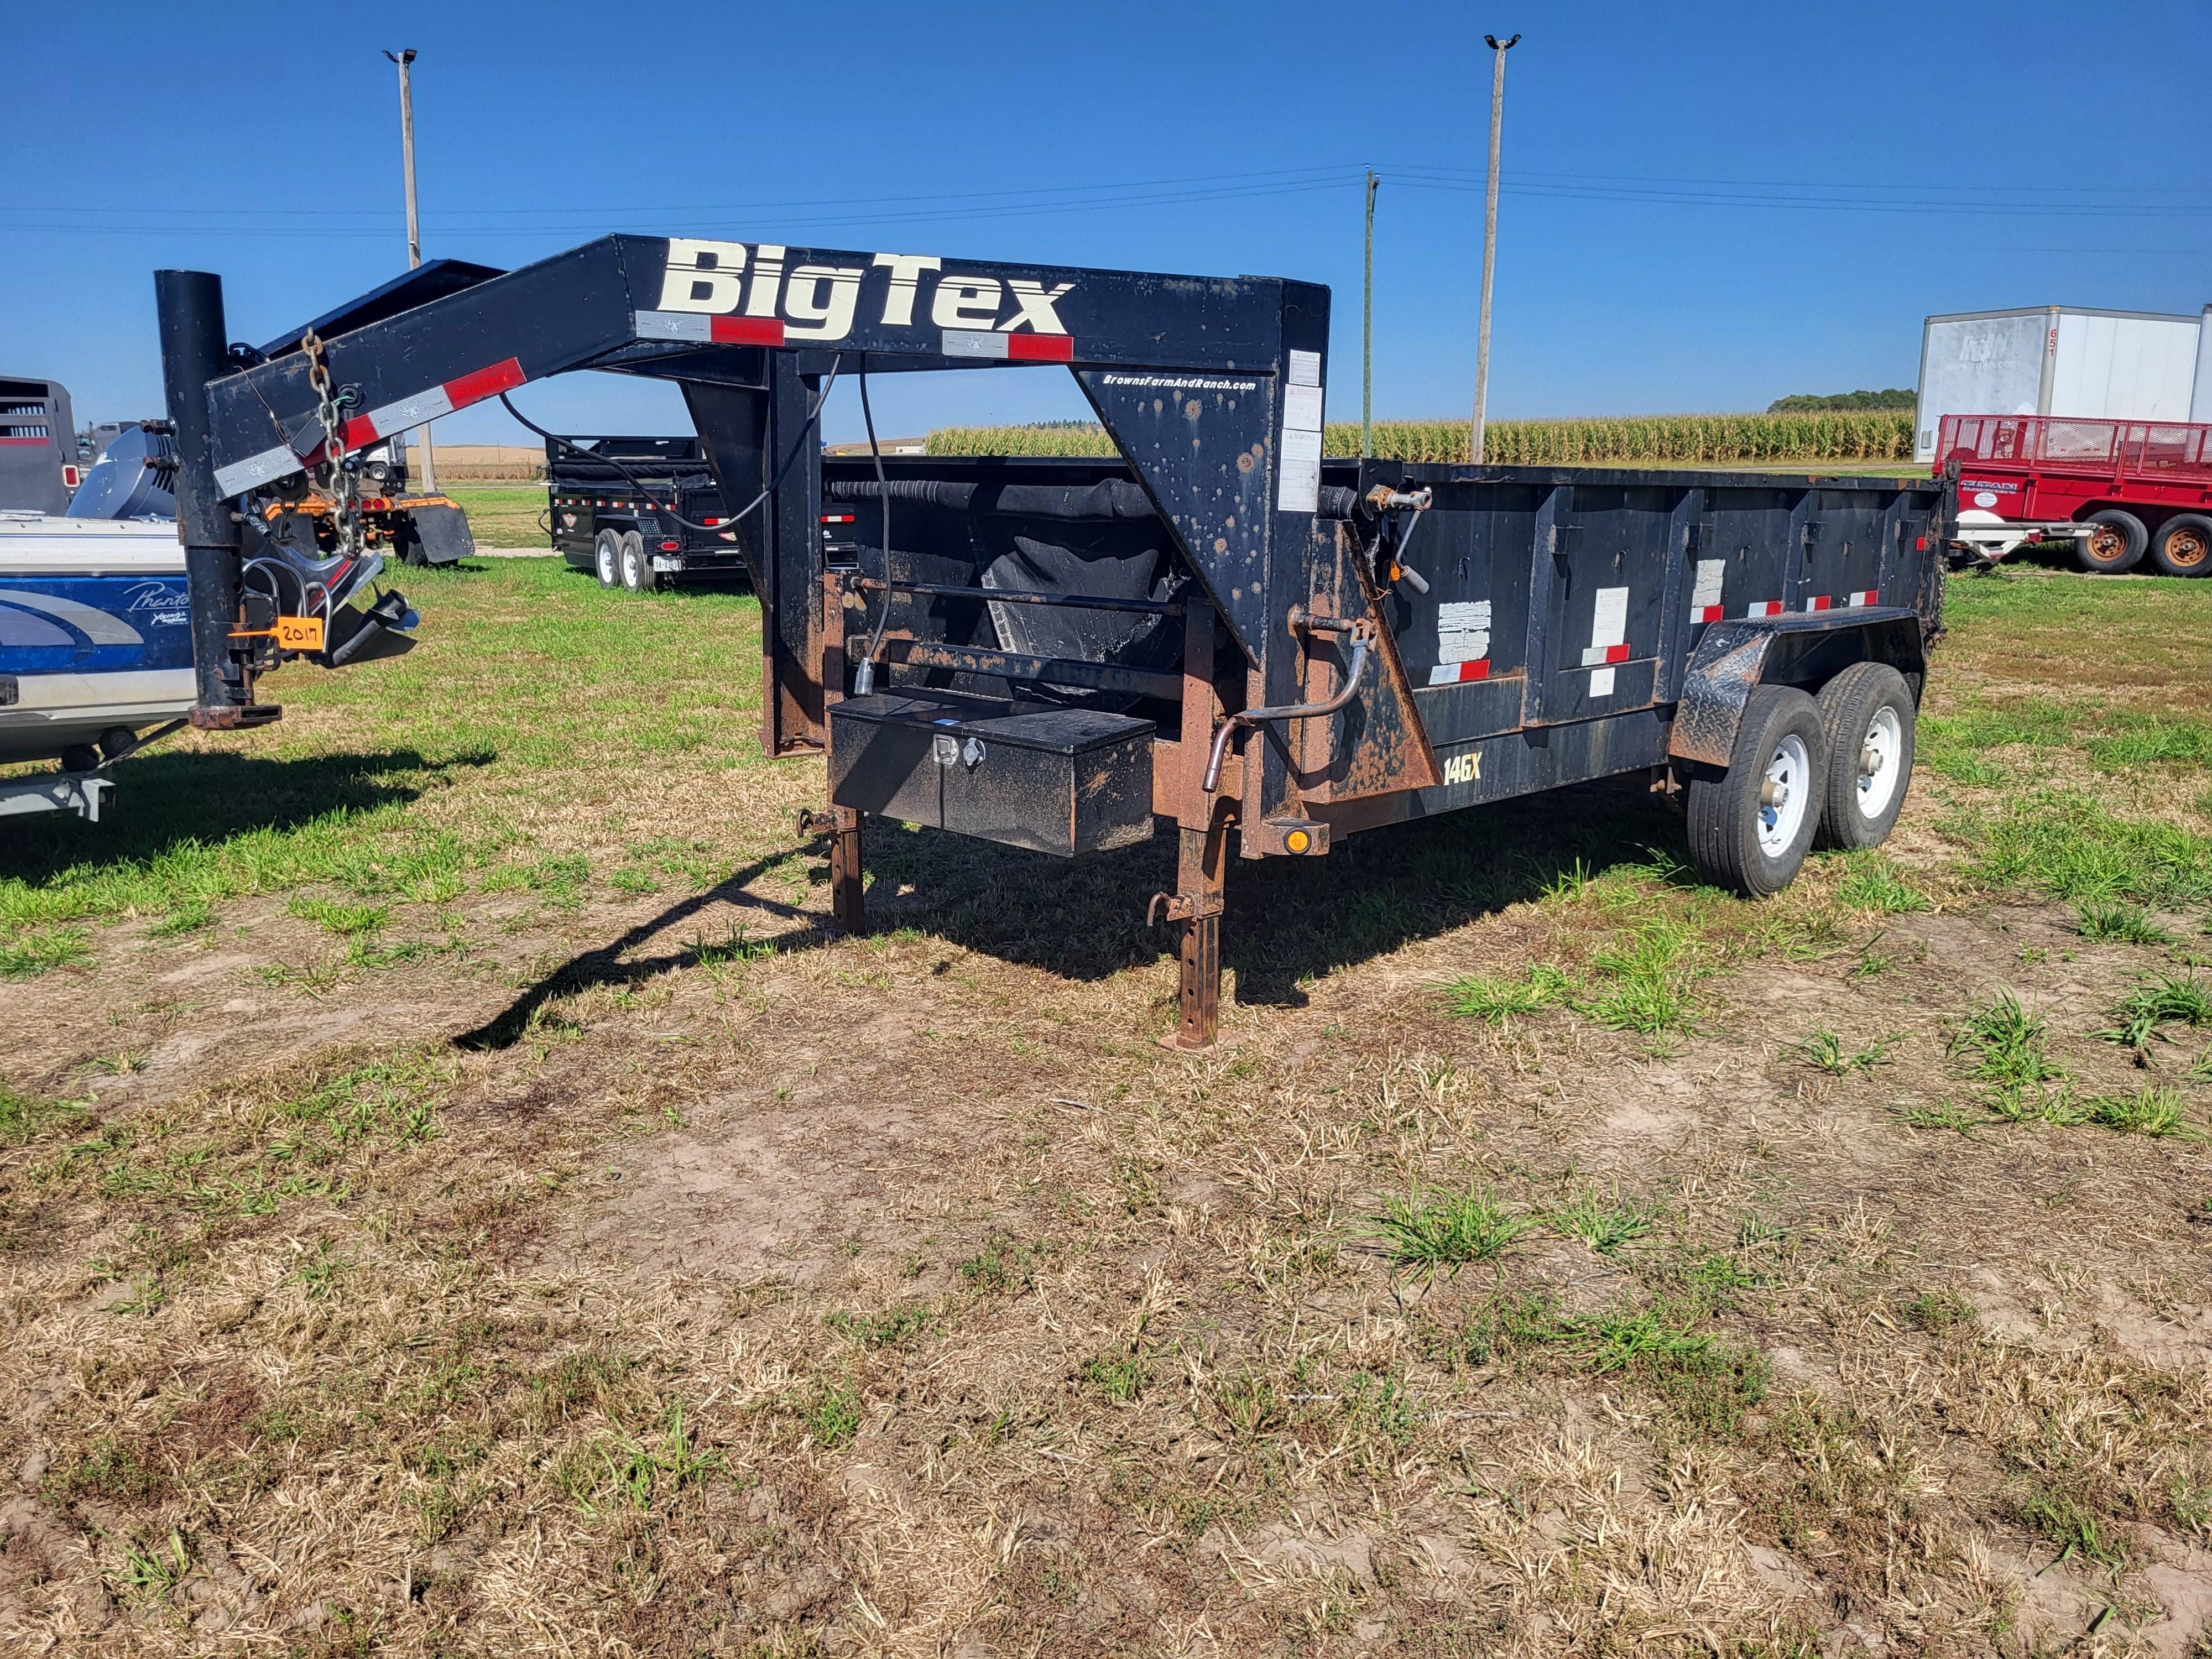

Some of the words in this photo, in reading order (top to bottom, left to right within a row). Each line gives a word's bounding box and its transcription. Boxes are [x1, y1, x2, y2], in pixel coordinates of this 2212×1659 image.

[1103, 374, 1256, 390] BrownsFarmAndRanch.com
[1960, 480, 2018, 494] TITAN
[283, 625, 317, 642] 2017
[1443, 752, 1483, 786] 14GX
